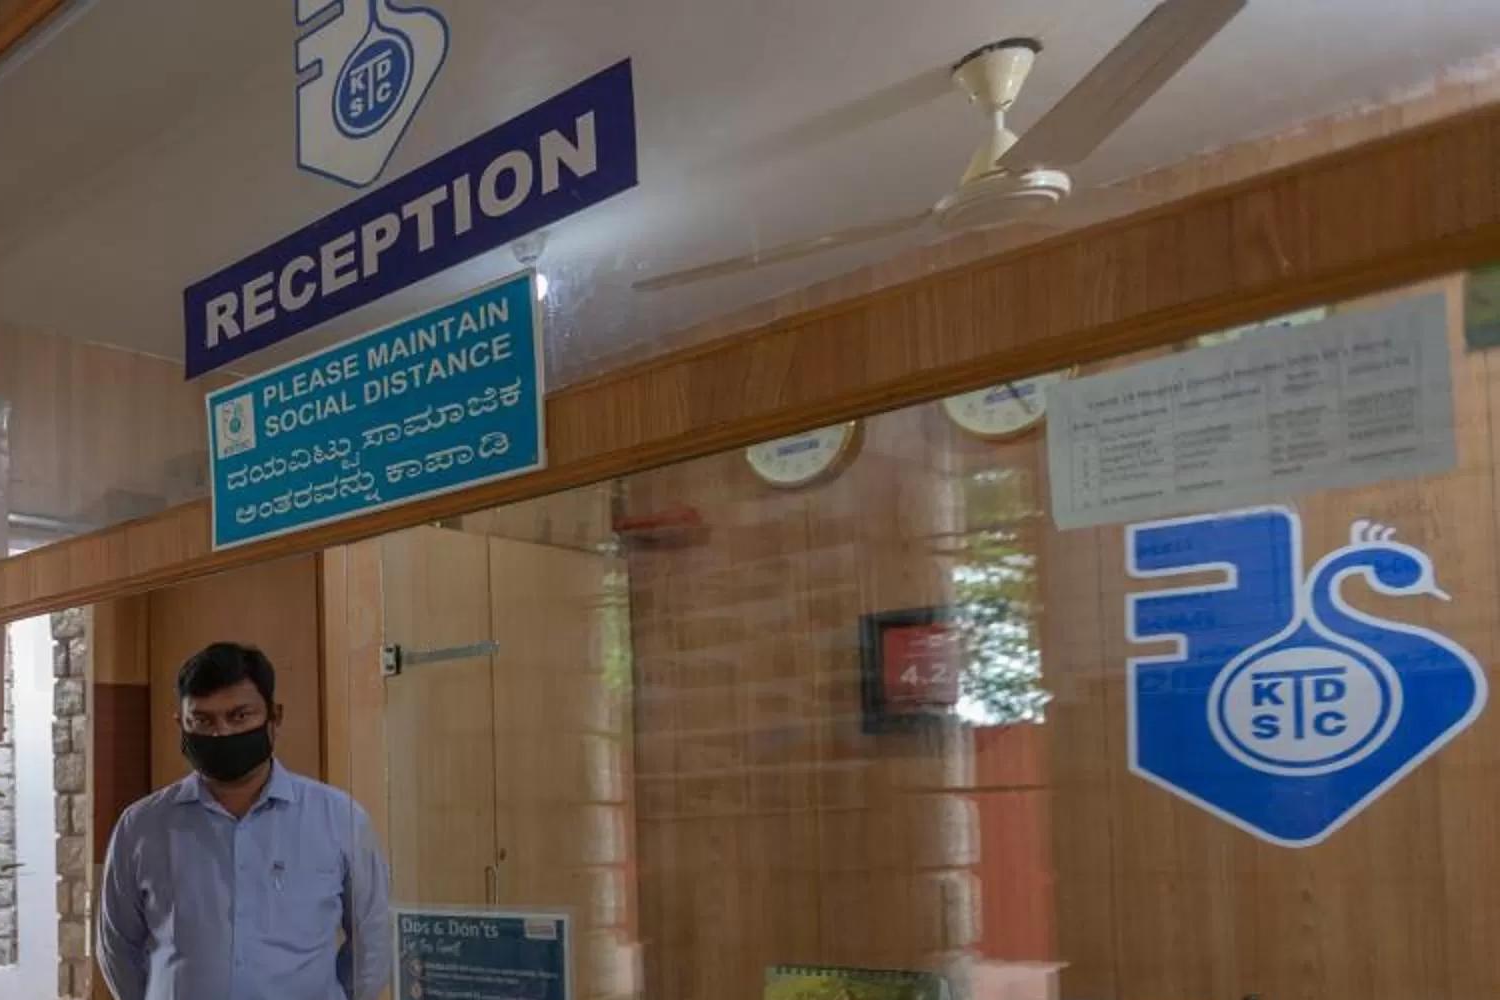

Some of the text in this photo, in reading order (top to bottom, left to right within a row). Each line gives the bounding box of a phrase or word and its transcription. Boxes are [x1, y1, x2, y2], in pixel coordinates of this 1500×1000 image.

[205, 111, 596, 348] RECEPTION
[262, 298, 510, 408] PLEASE MAINTAIN
[264, 334, 512, 438] SOCIAL DISTANCE
[226, 434, 361, 490] ದಯವಿಟ್ಟು
[235, 430, 510, 525] ಅಂತರವನ್ನು ಕಾಪಾಡಿ
